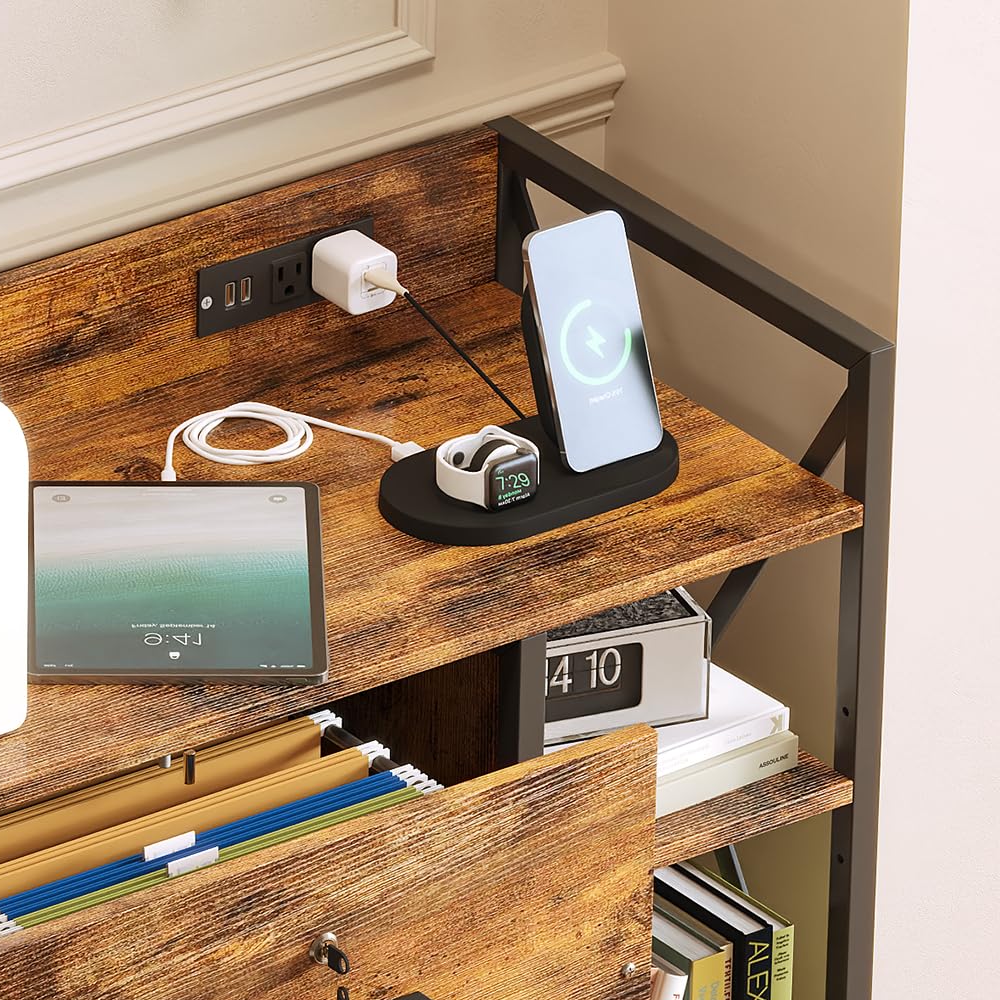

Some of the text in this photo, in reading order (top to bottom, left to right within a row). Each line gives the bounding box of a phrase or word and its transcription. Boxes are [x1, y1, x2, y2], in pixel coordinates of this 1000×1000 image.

[495, 473, 530, 490] 7:29
[585, 647, 622, 689] 10
[758, 753, 790, 770] ASSOULINE
